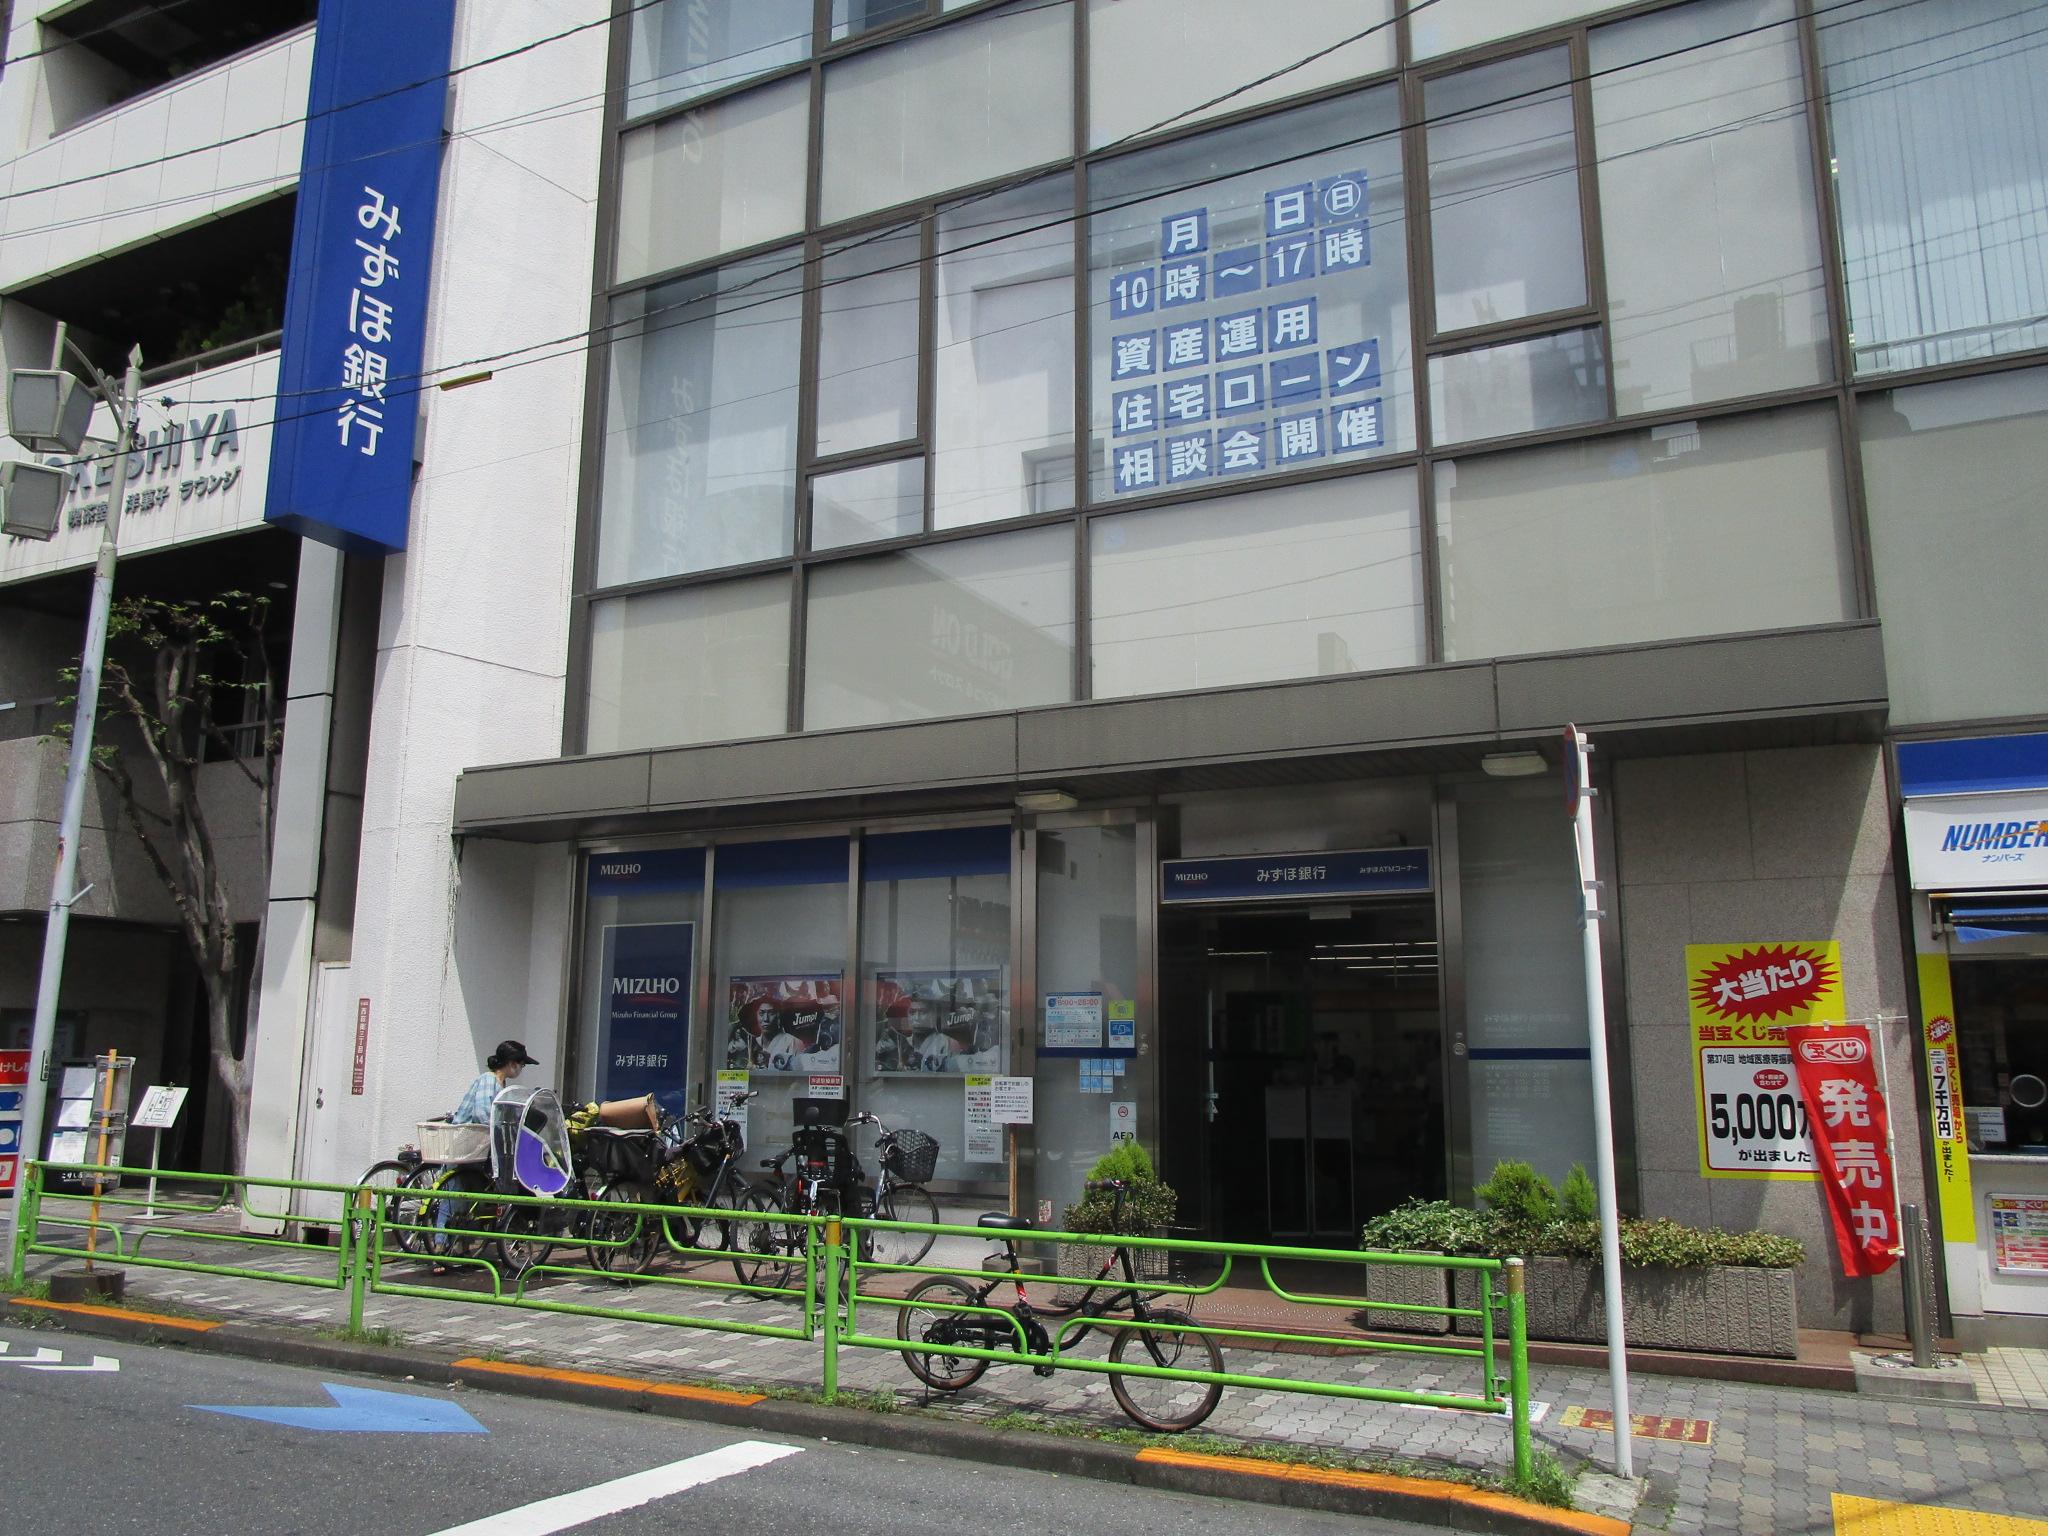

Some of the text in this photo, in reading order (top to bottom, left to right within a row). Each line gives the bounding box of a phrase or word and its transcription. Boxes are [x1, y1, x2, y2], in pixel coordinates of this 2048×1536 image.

[336, 185, 402, 457] みずほ銀行
[1116, 303, 1311, 376] 資産運用
[1117, 352, 1371, 433] 住宅ローン
[1119, 405, 1378, 487] 相談会開催
[179, 465, 242, 501] ラウンジ
[1982, 853, 2025, 863] ナンバーズ
[600, 863, 641, 876] MIZUHO
[1175, 872, 1208, 881] MIZUHO
[1256, 866, 1327, 883] みずほ銀行
[1359, 865, 1419, 874] みずほATMコーナー
[611, 977, 680, 995] MIZUHO
[1712, 958, 1814, 1008] 大当たり
[611, 1011, 678, 1021] Mizuho Financial Group
[615, 1054, 667, 1068] みずほ銀行
[1112, 1131, 1134, 1141] AED
[1738, 1149, 1812, 1163] が出ました
[1818, 1078, 1889, 1249] 発売中
